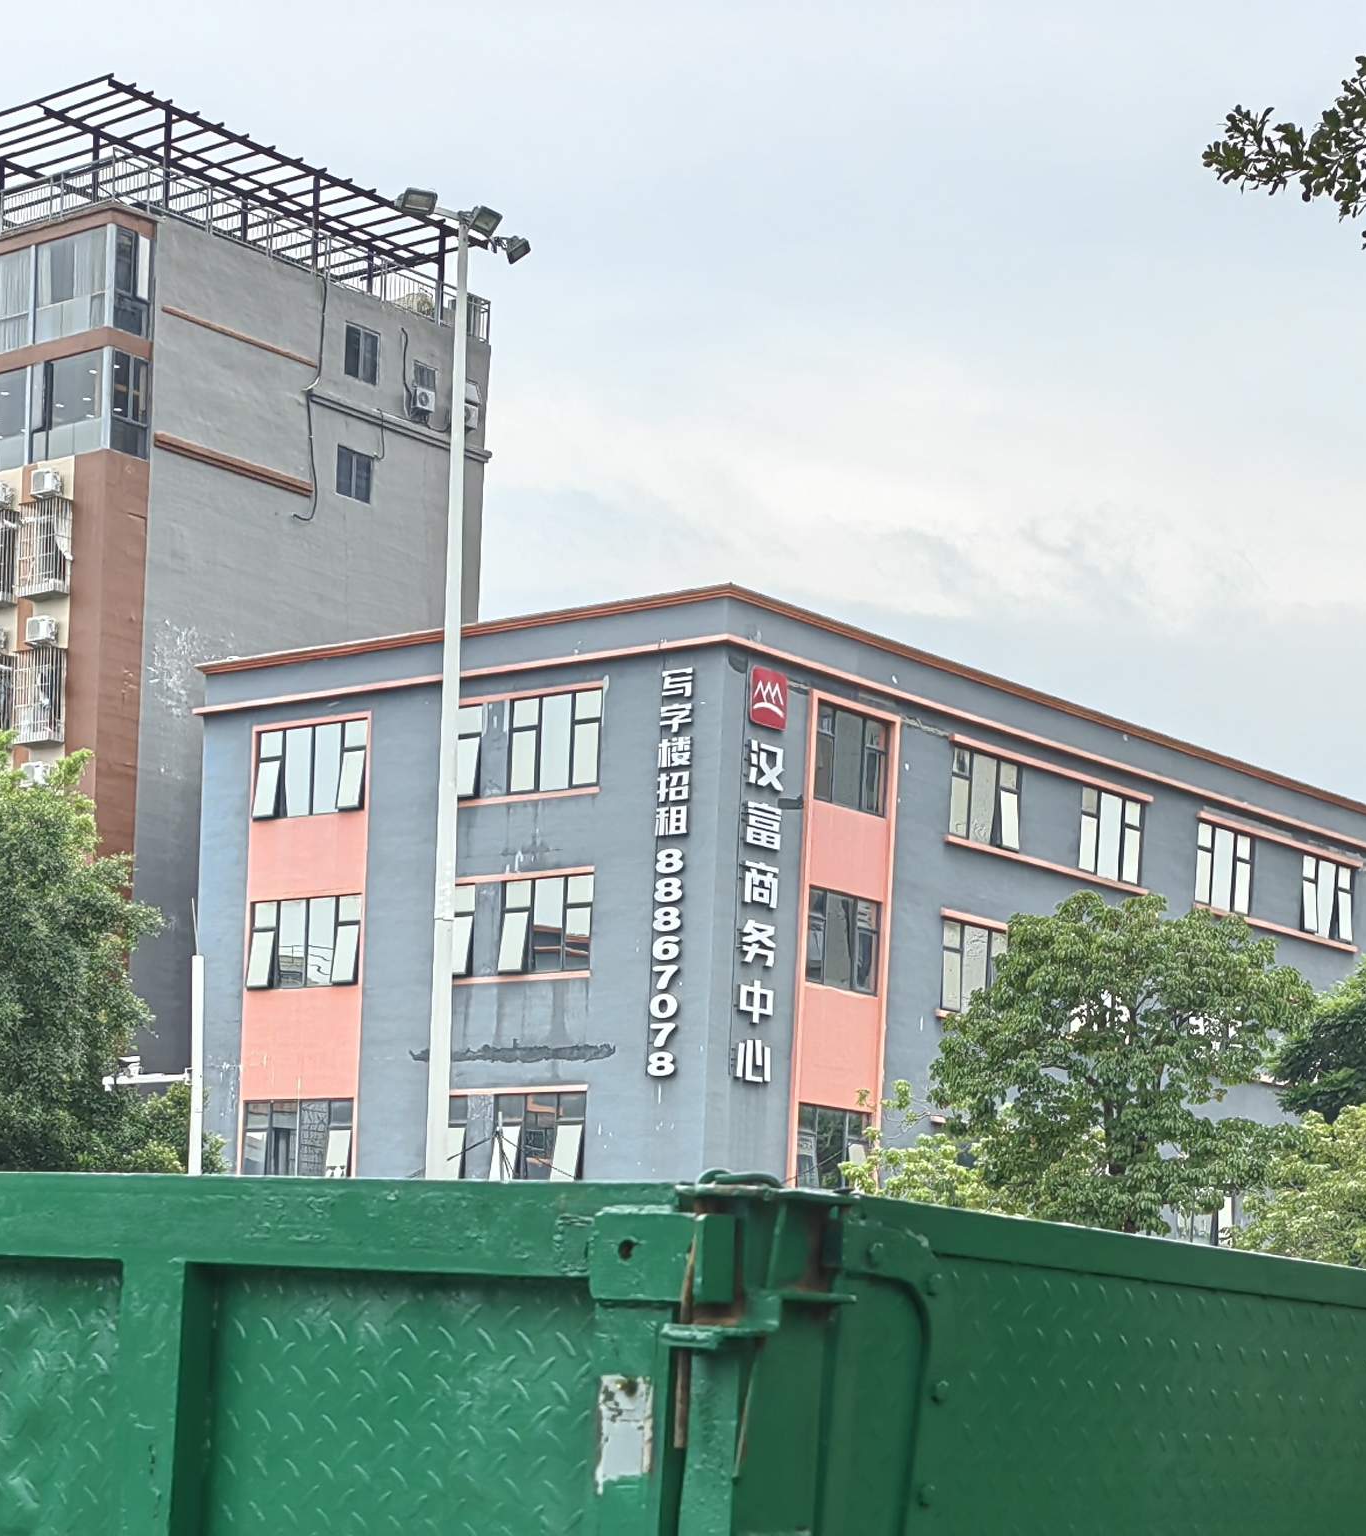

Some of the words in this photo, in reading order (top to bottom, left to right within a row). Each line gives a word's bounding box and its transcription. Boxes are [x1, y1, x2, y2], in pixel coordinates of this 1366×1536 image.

[655, 667, 693, 836] 写字楼招租
[647, 848, 683, 1077] 88867078
[735, 739, 784, 1083] 汉富商务中心
